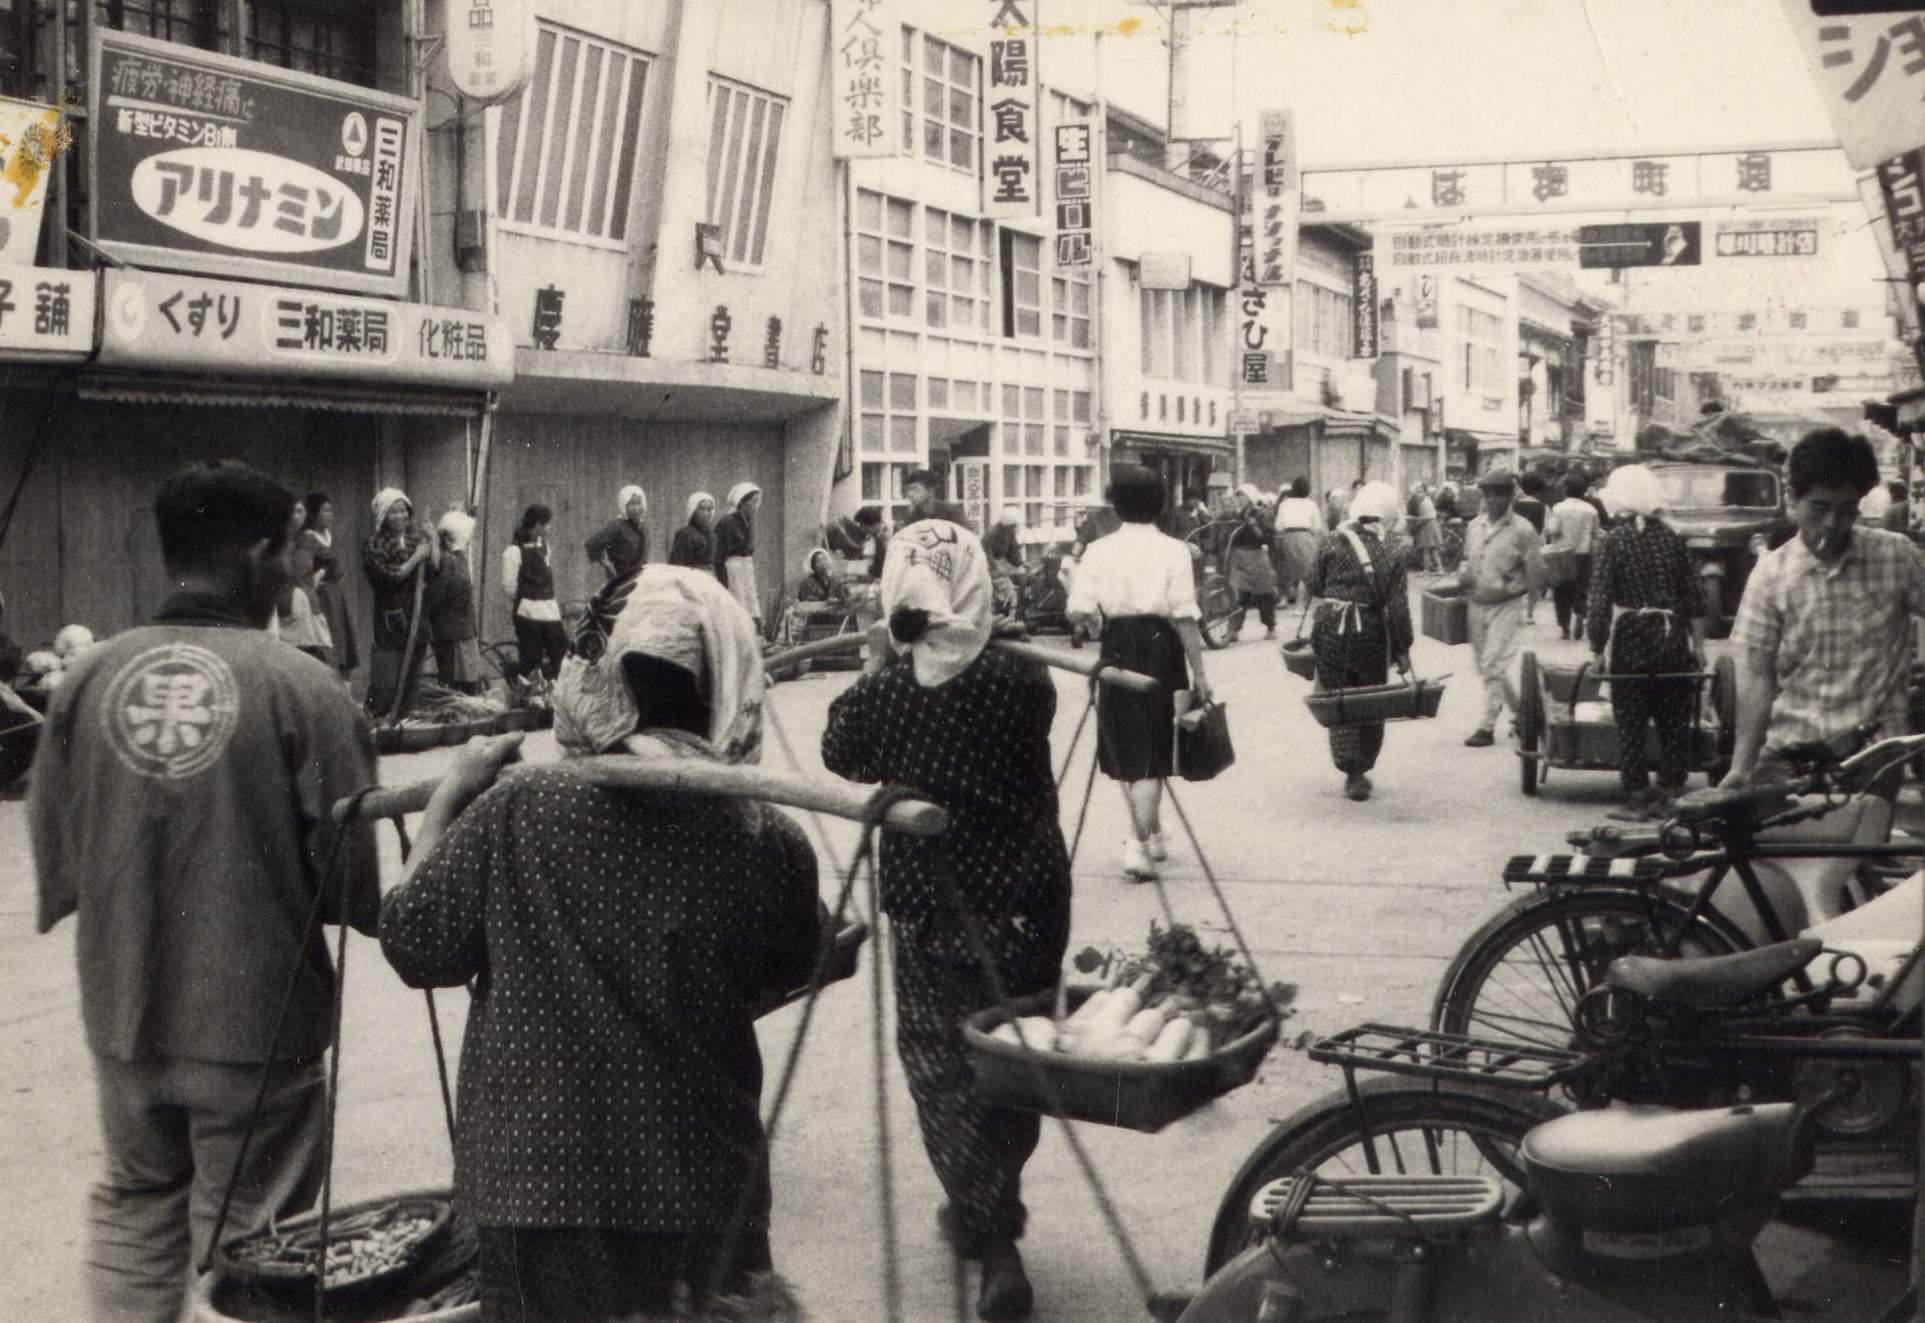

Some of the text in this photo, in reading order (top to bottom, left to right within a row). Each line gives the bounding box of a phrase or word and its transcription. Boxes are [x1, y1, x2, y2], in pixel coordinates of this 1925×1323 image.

[155, 160, 344, 241] アリナミン
[370, 126, 398, 260] 三和薬局
[159, 290, 488, 361] くすり 三和薬局 化粧品
